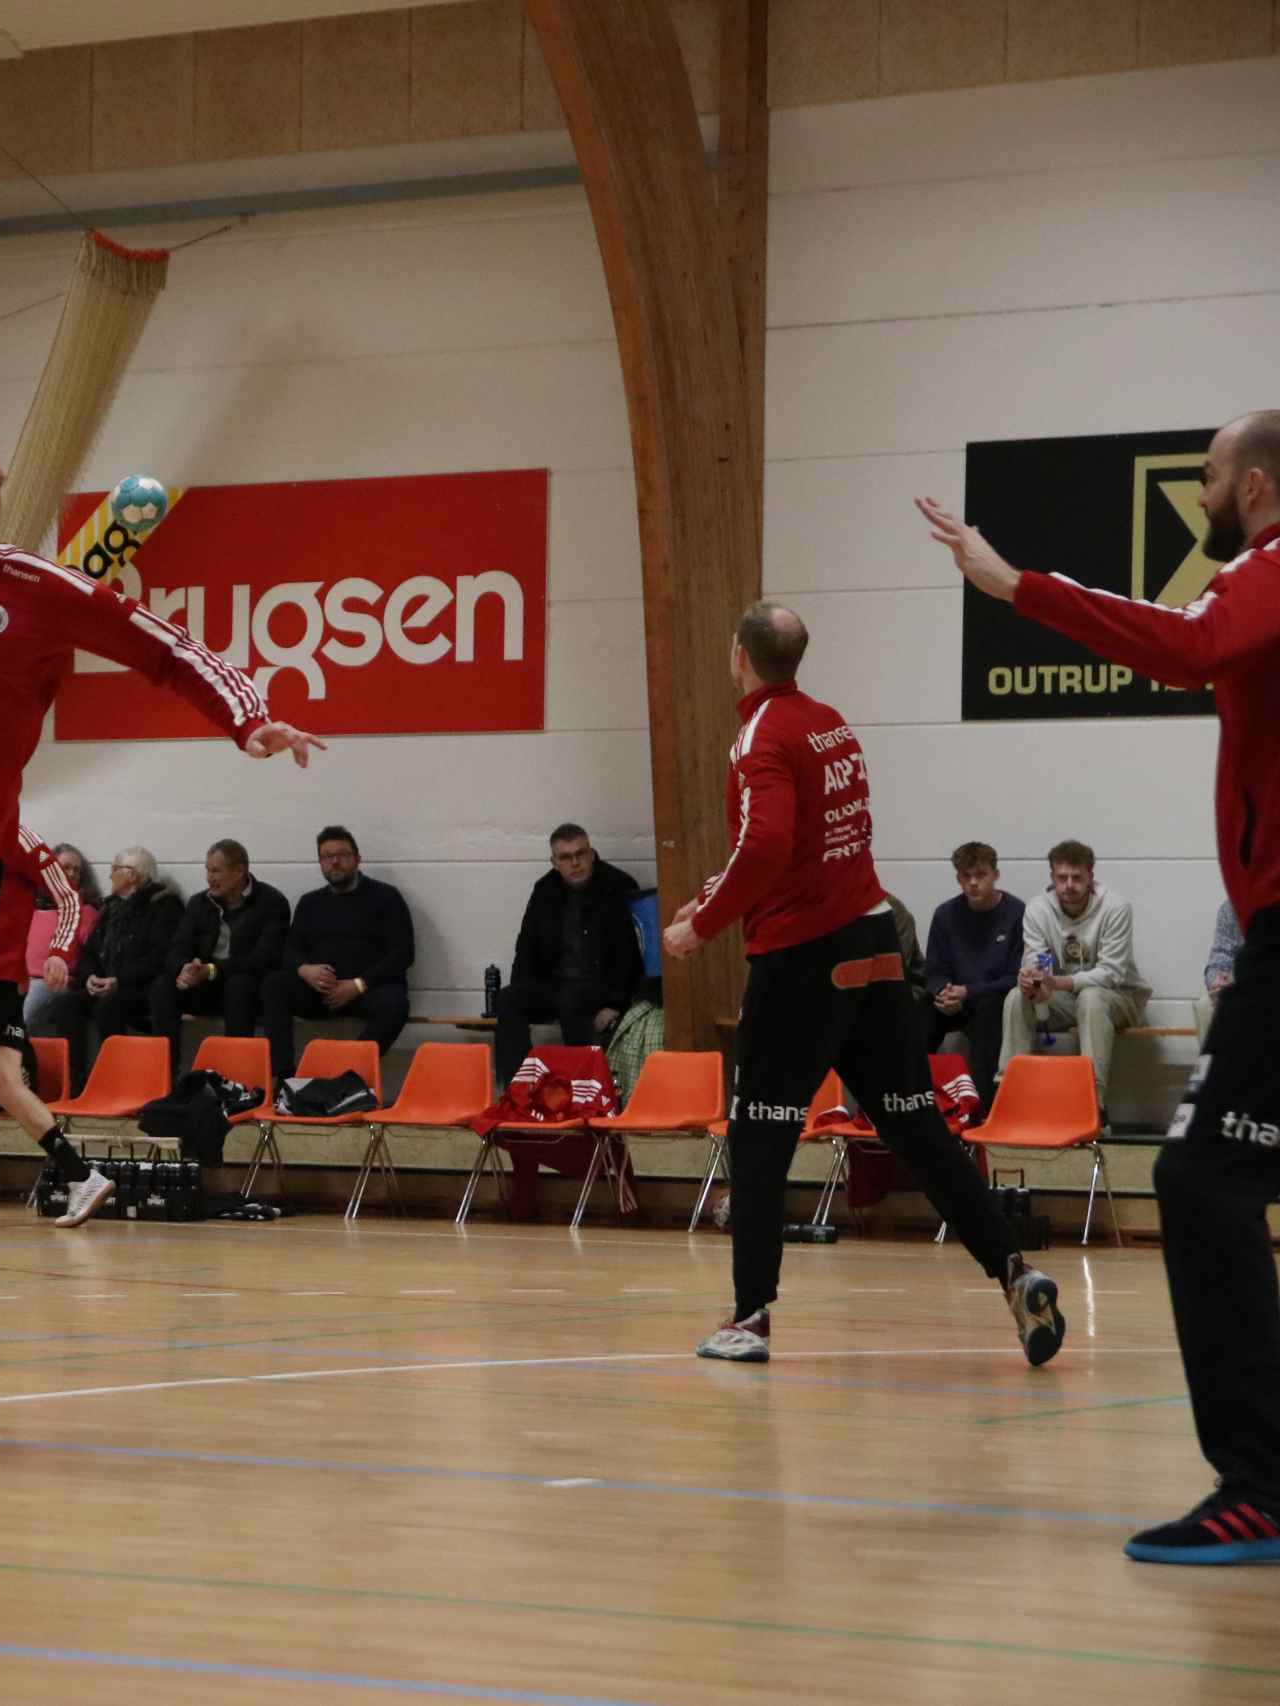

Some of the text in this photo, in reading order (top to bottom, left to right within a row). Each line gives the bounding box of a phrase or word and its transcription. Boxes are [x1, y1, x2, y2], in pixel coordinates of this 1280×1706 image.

[64, 519, 141, 579] ag
[2, 563, 40, 583] thansen
[987, 664, 1134, 696] OUTRUP
